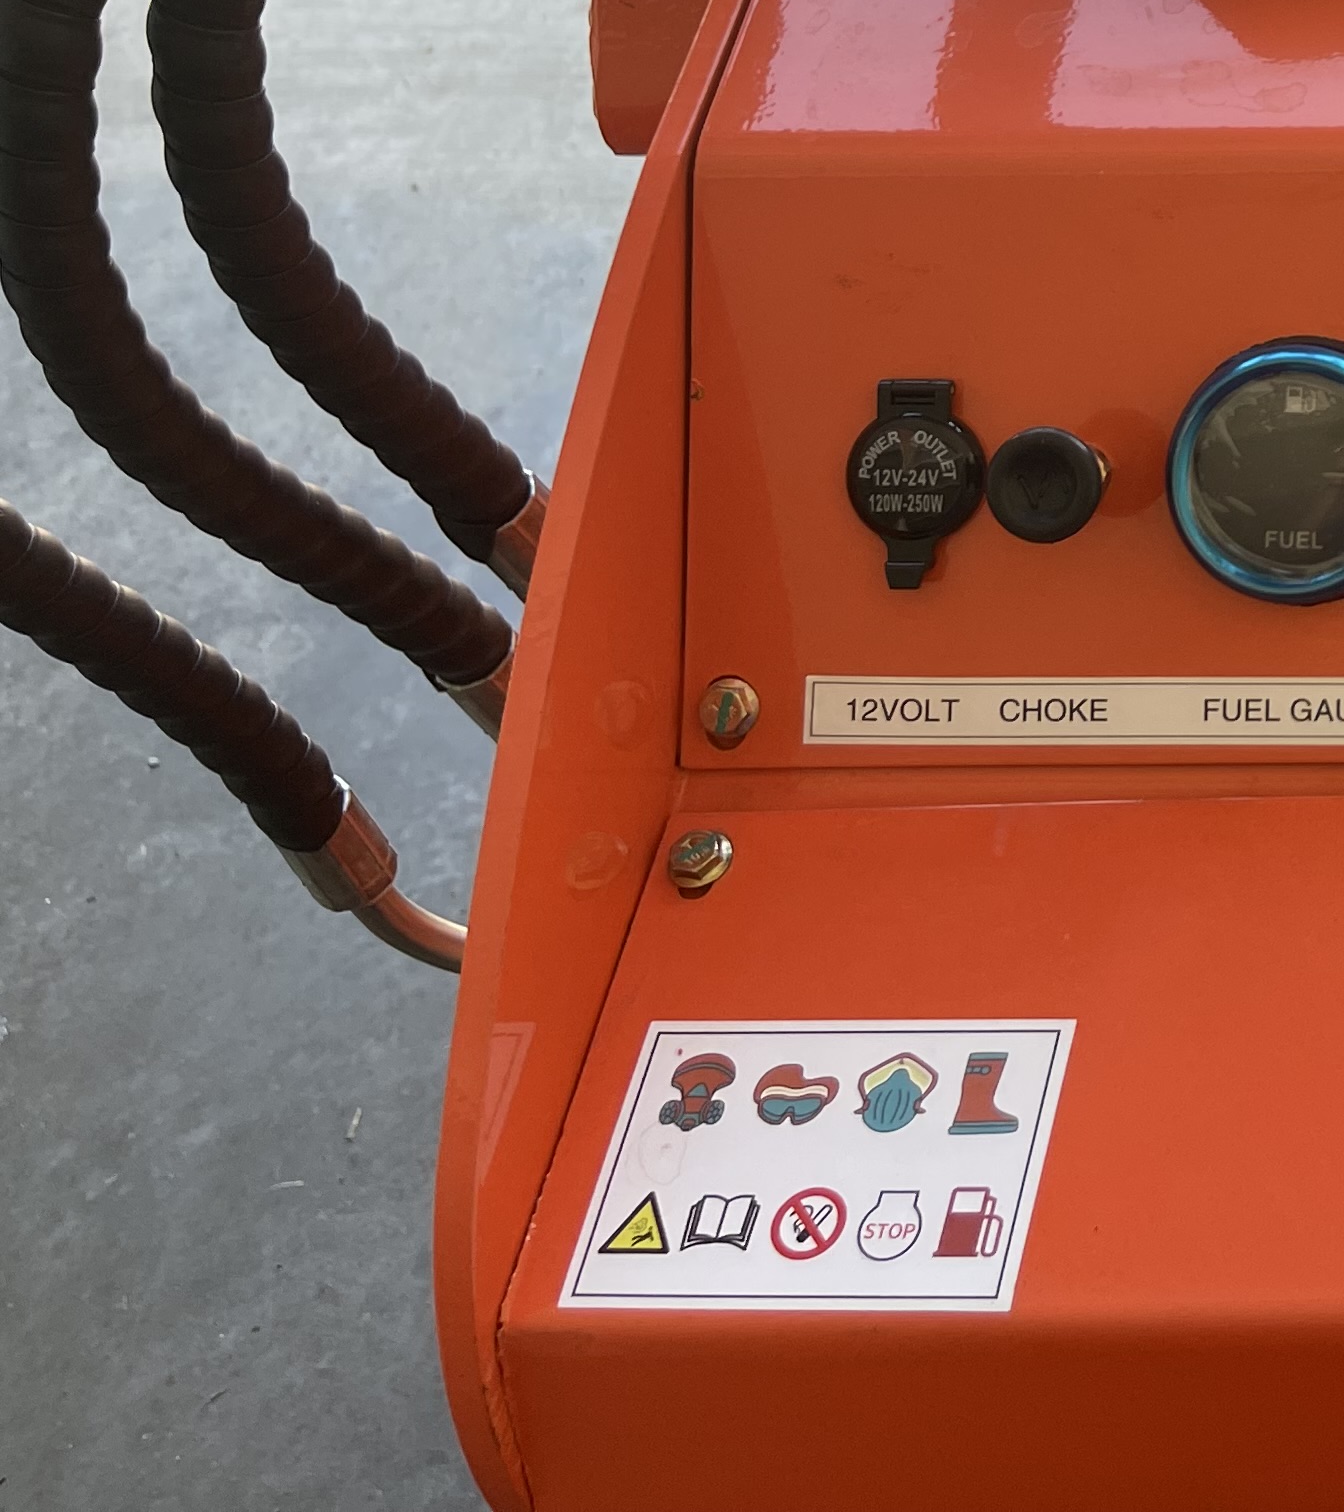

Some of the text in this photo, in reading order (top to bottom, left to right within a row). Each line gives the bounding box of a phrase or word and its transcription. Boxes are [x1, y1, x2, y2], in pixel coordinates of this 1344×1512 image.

[858, 430, 957, 481] POWER OUTLET
[873, 469, 940, 487] 12V-24V
[868, 494, 944, 513] 120W-250W
[1264, 530, 1323, 549] FUEL
[846, 697, 961, 723] 12VOLT
[999, 697, 1109, 723] CHOKE
[1202, 697, 1282, 723] FUEL
[863, 1223, 916, 1240] STOP
